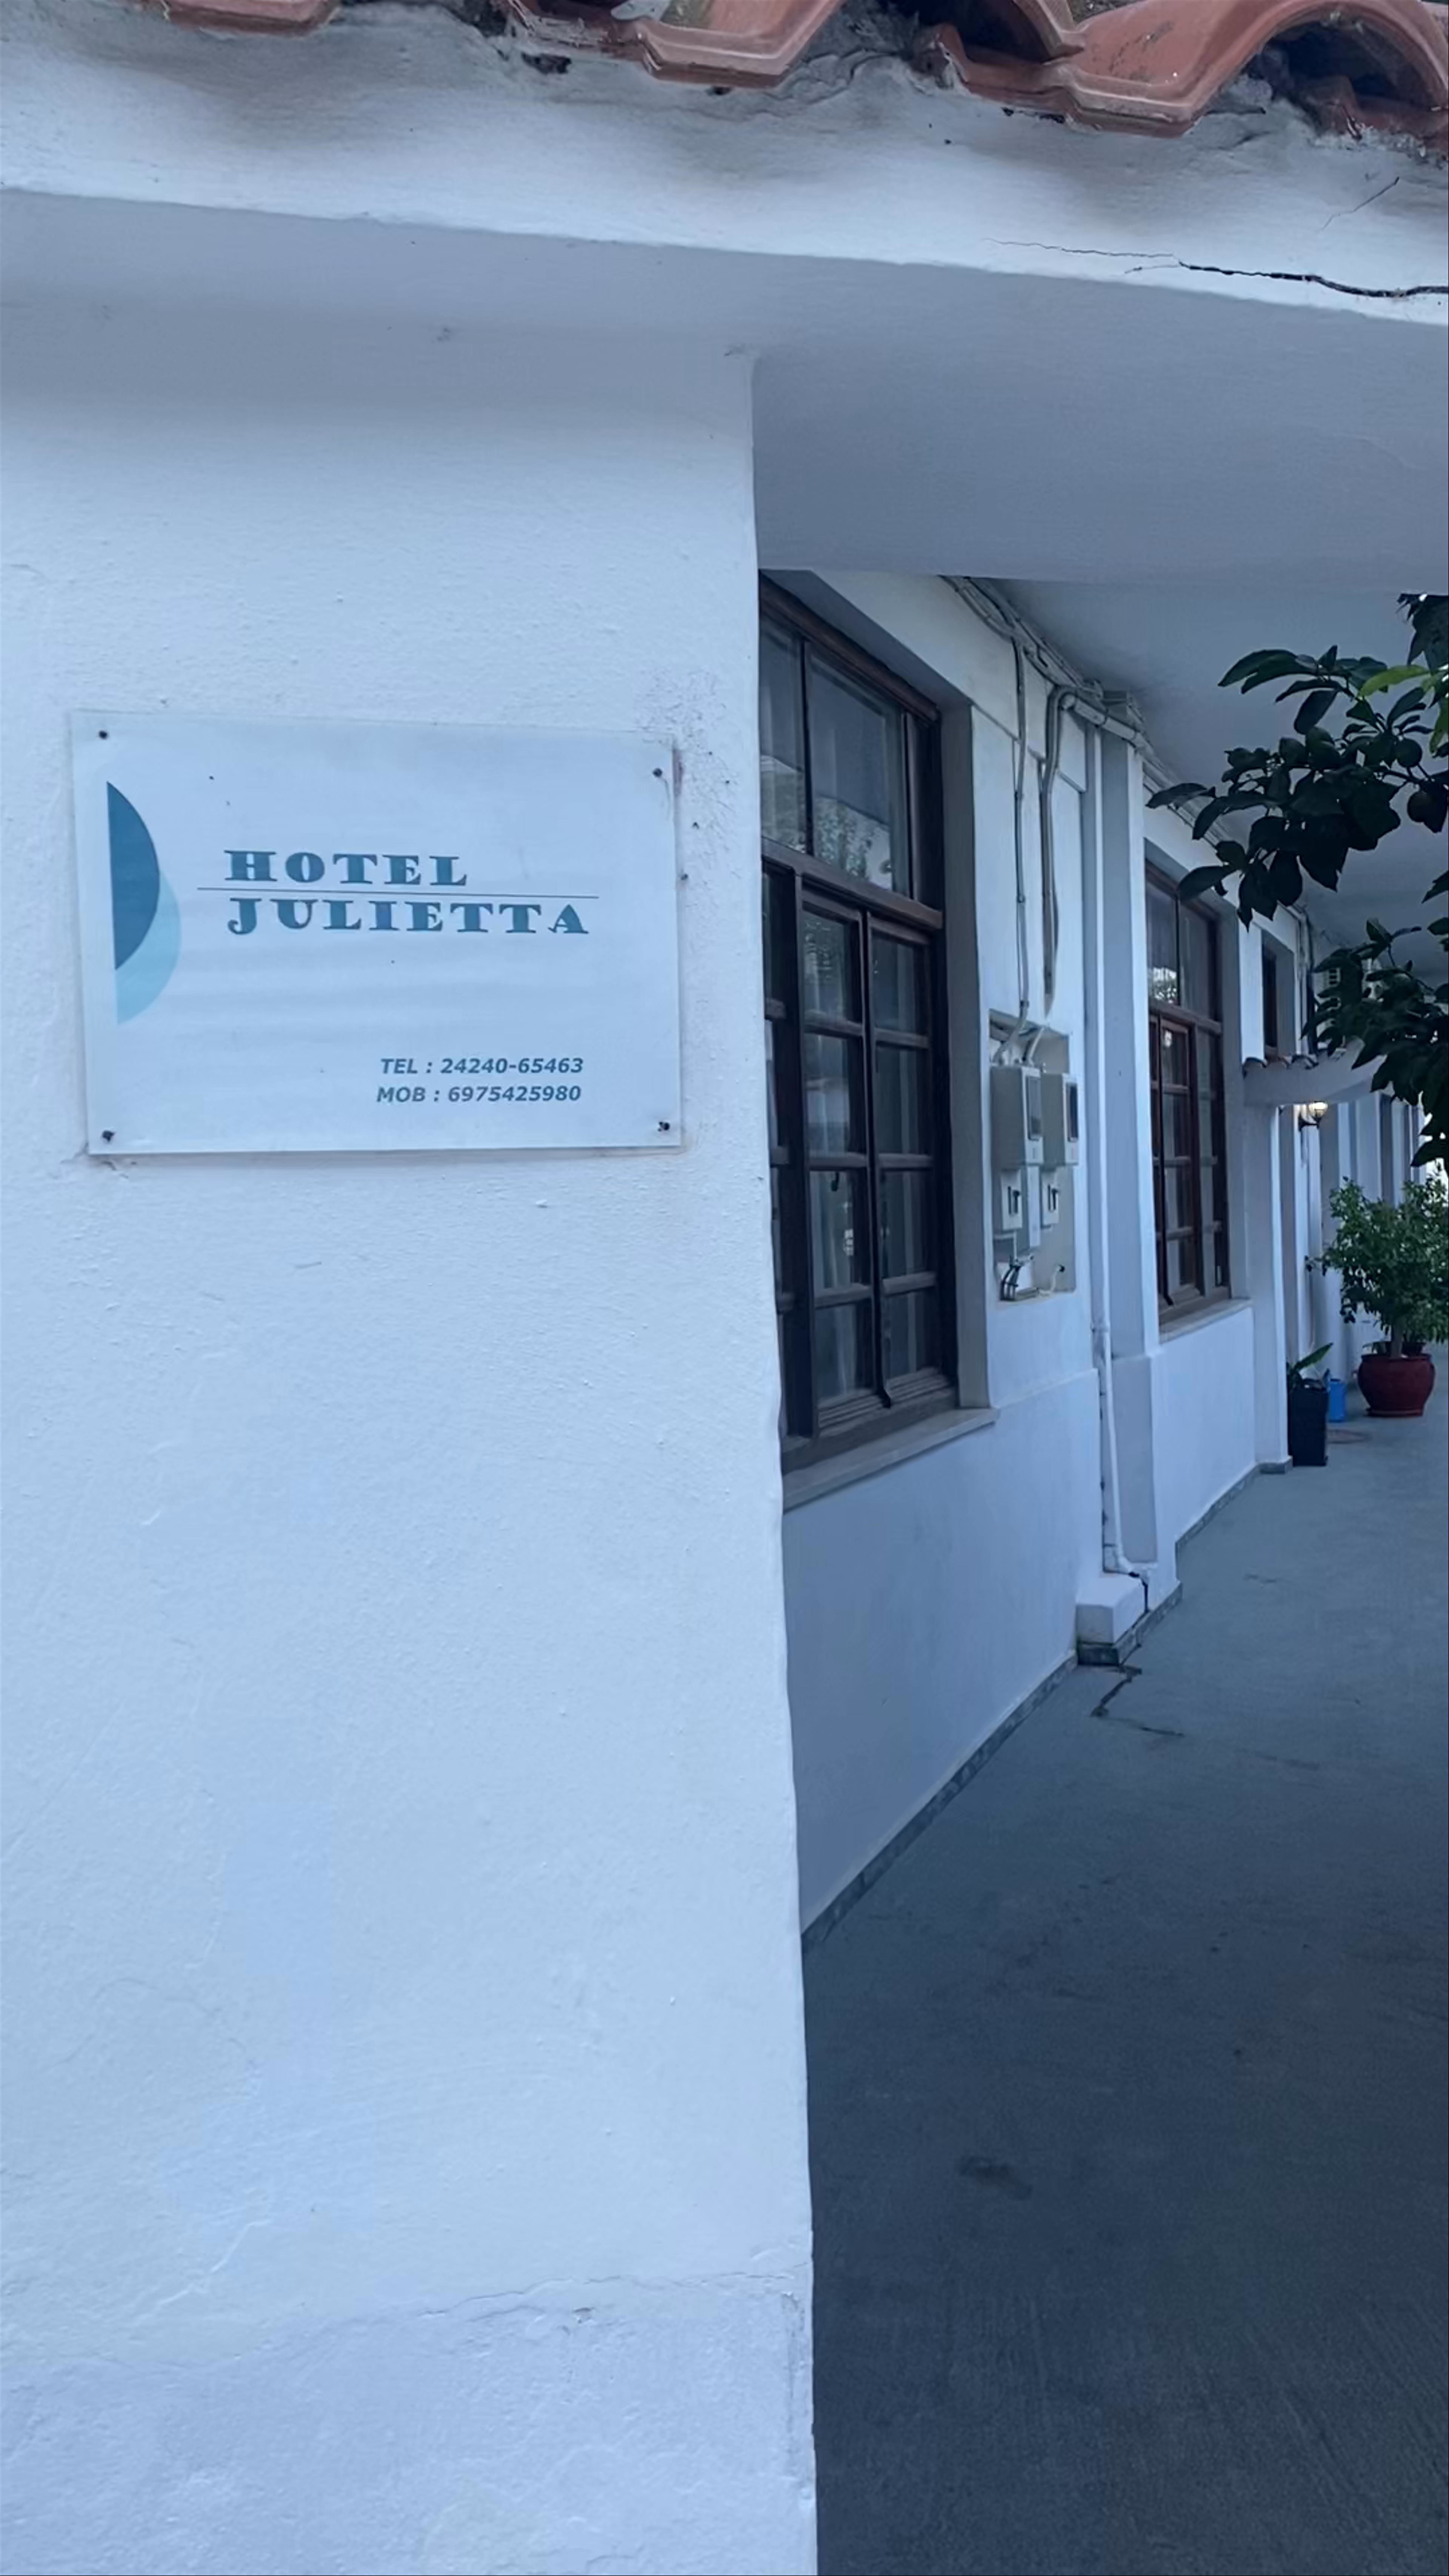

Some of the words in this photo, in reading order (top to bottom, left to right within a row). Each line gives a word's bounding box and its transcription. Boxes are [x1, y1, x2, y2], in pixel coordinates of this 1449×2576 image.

[223, 849, 468, 887] HOTEL
[227, 897, 589, 935] JULIETTA
[380, 1058, 419, 1075] TEL
[439, 1057, 585, 1075] 24240-65463
[375, 1086, 426, 1103] MOB
[448, 1085, 582, 1103] 6975425980
